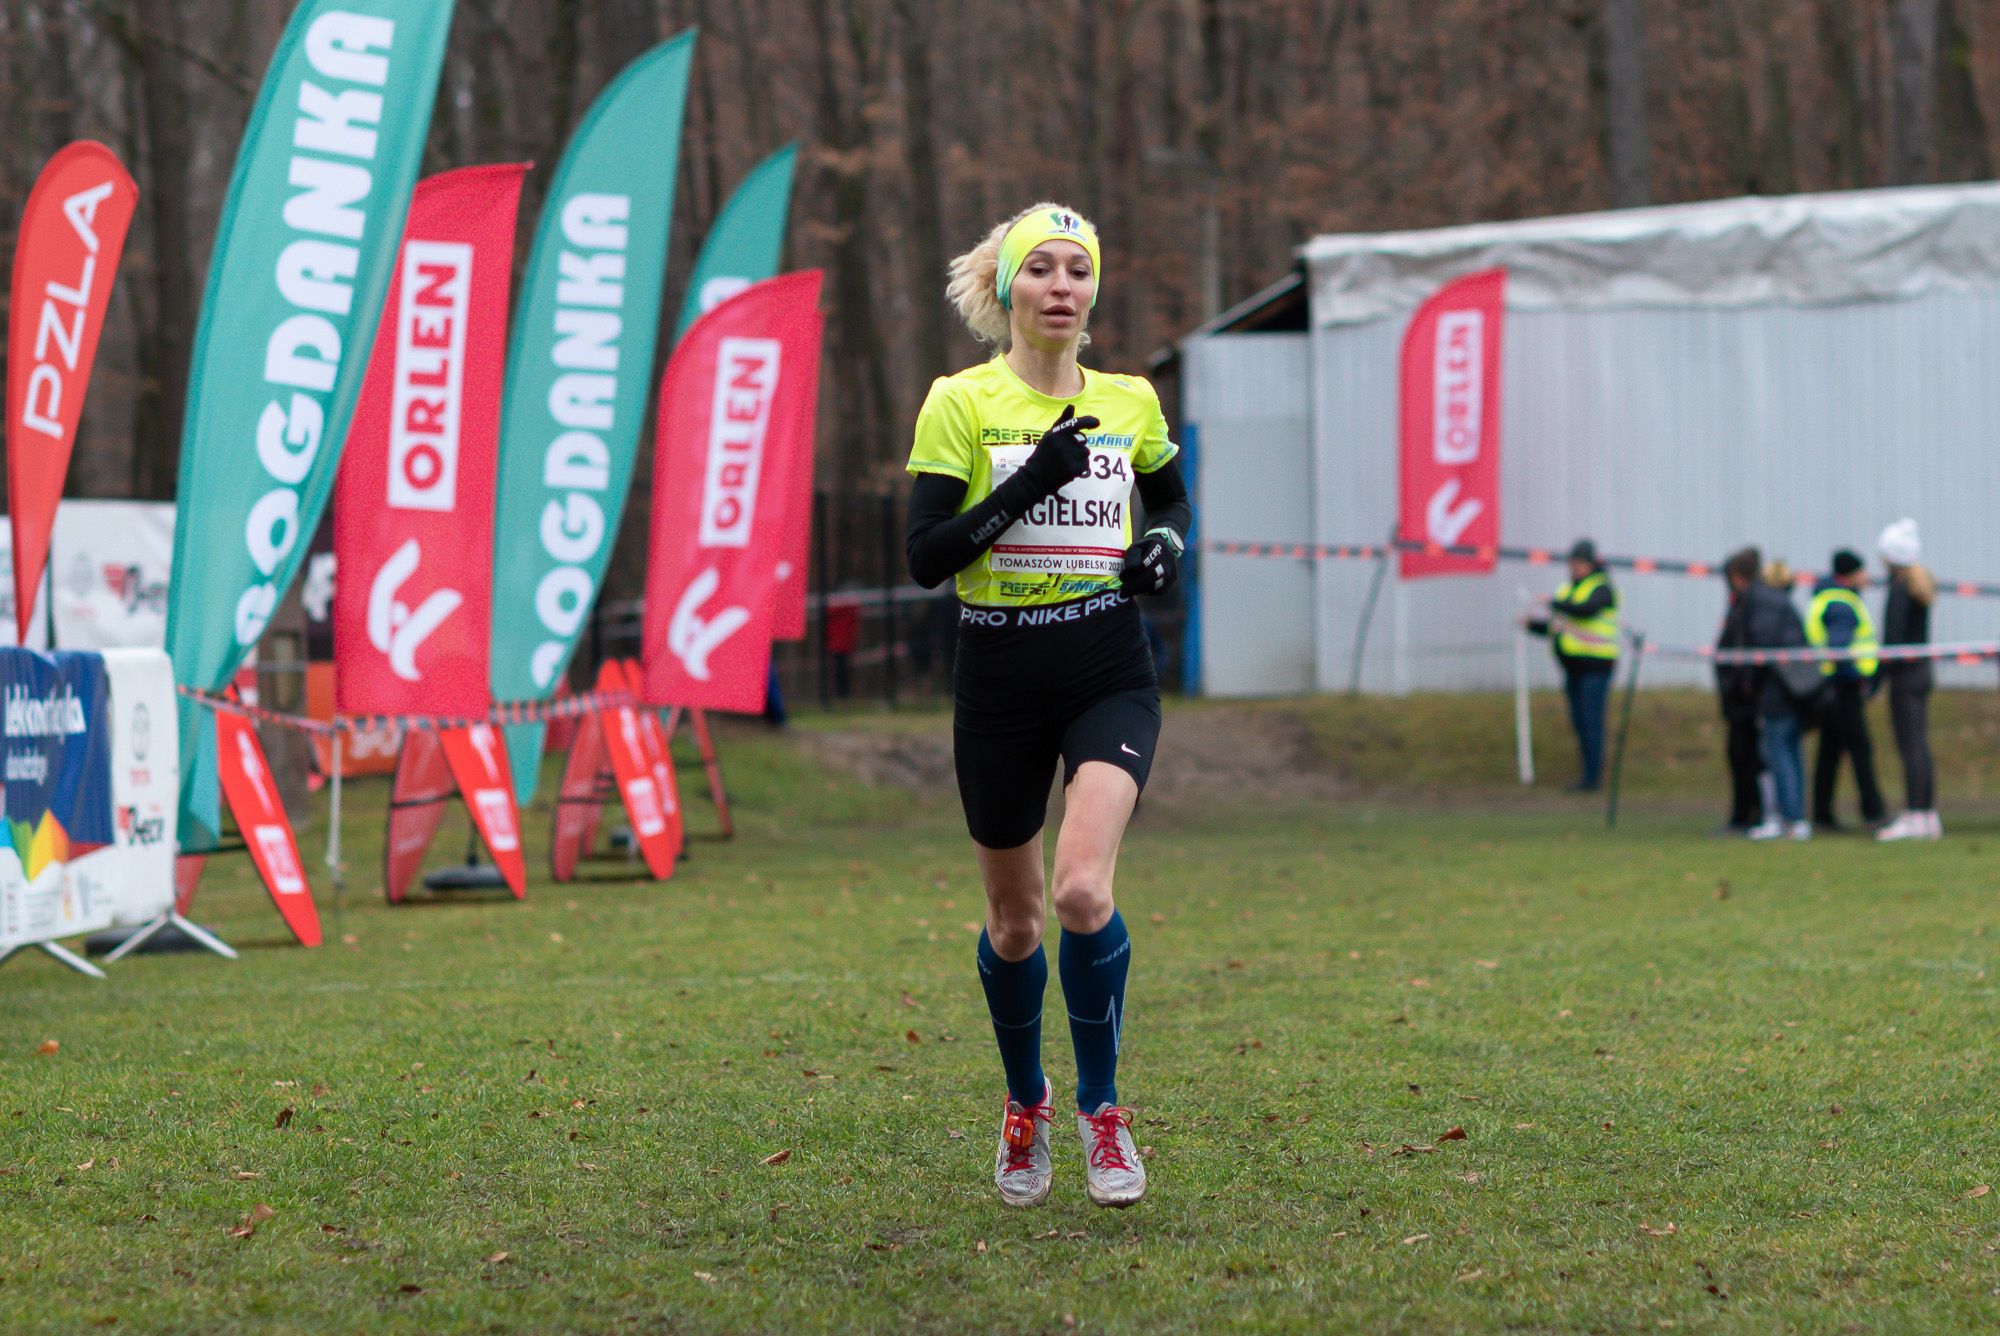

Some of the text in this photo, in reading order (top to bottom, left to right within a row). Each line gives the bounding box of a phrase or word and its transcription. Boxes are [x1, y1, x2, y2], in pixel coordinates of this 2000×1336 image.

[23, 181, 114, 439] PZLA
[402, 263, 458, 491] ORLEN
[714, 355, 767, 530] ORLEN
[982, 428, 1043, 446] PREFBE
[1080, 454, 1127, 482] 34
[999, 556, 1063, 569] TOMASZÓW
[1066, 559, 1107, 571] LUBELSKI
[961, 607, 1008, 627] PRO
[1017, 603, 1082, 627] NIKE
